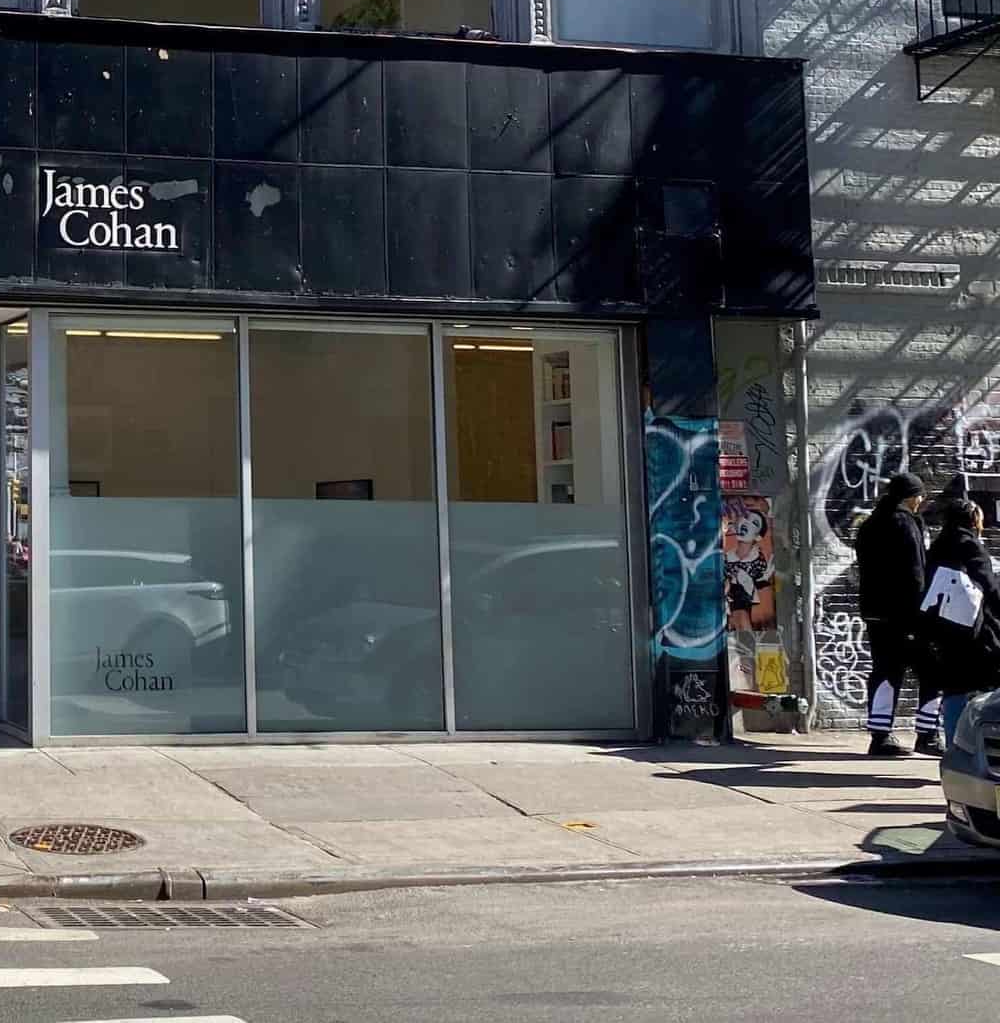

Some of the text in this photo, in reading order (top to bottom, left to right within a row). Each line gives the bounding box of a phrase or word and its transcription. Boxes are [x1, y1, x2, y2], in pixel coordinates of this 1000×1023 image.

[42, 167, 145, 217] James
[58, 210, 180, 251] Cohan
[95, 645, 155, 673] James
[104, 669, 174, 692] Cohan
